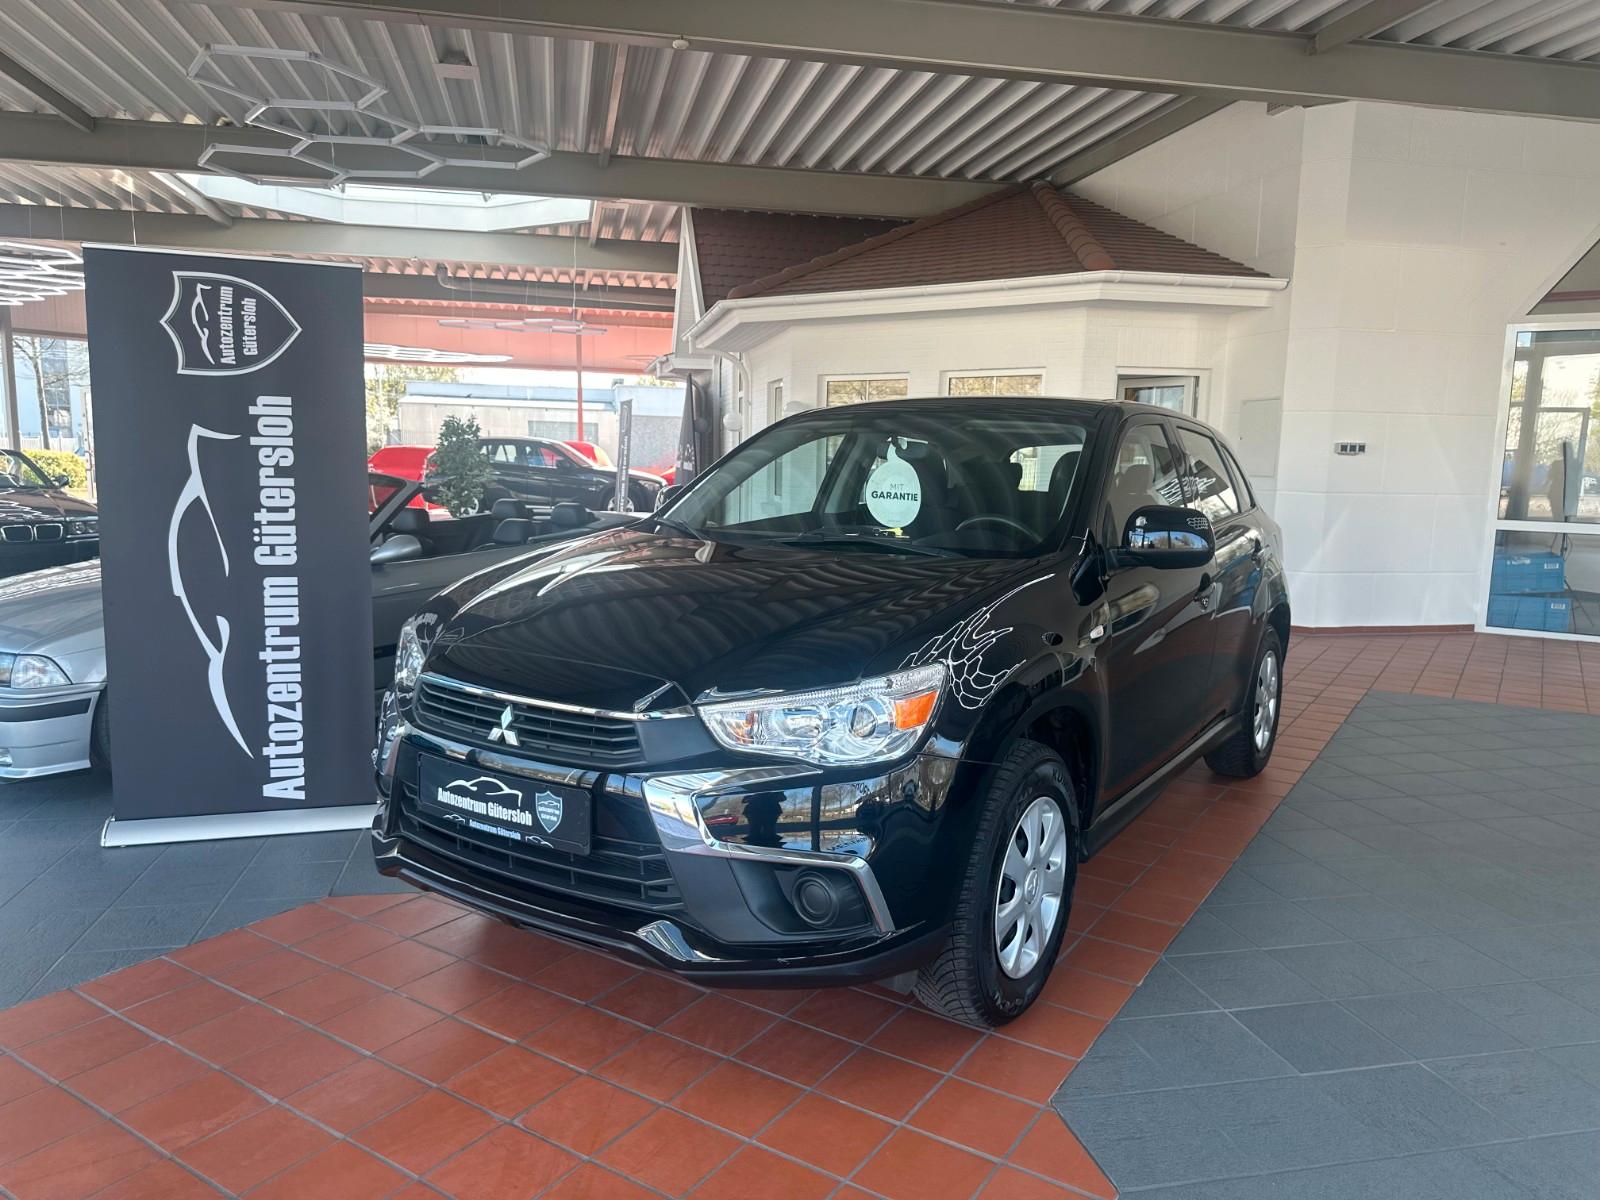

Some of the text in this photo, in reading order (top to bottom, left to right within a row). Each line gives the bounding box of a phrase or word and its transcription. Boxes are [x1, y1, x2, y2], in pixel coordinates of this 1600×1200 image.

[218, 286, 236, 364] Autozentrum
[241, 298, 258, 355] Gütersloh
[871, 490, 918, 501] GARANTIE
[249, 395, 306, 800] Autozentrum Gütersloh
[437, 787, 487, 815] Autozentrum
[487, 801, 533, 826] Gütersloh
